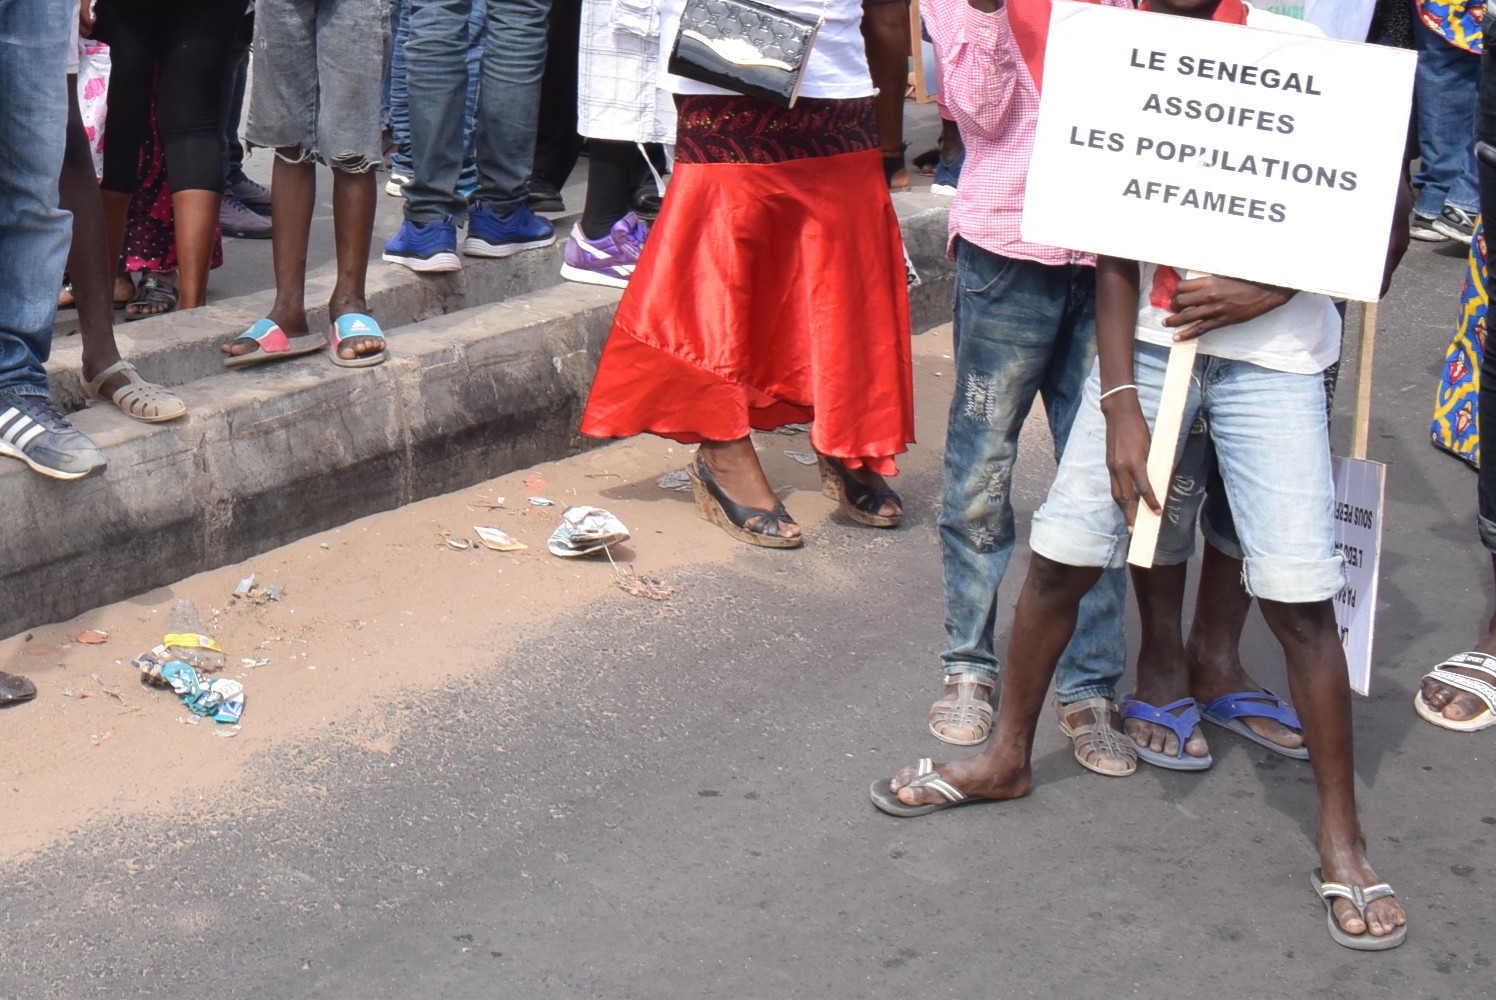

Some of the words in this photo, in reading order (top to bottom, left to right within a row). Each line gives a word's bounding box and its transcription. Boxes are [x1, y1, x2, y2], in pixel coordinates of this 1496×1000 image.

[1129, 48, 1167, 72] LE
[1176, 55, 1322, 96] SENEGAL
[1142, 93, 1296, 135] ASSOIFES
[1069, 125, 1125, 152] LES
[1122, 178, 1287, 223] AFFAMEES
[1354, 507, 1373, 530] SOUS
